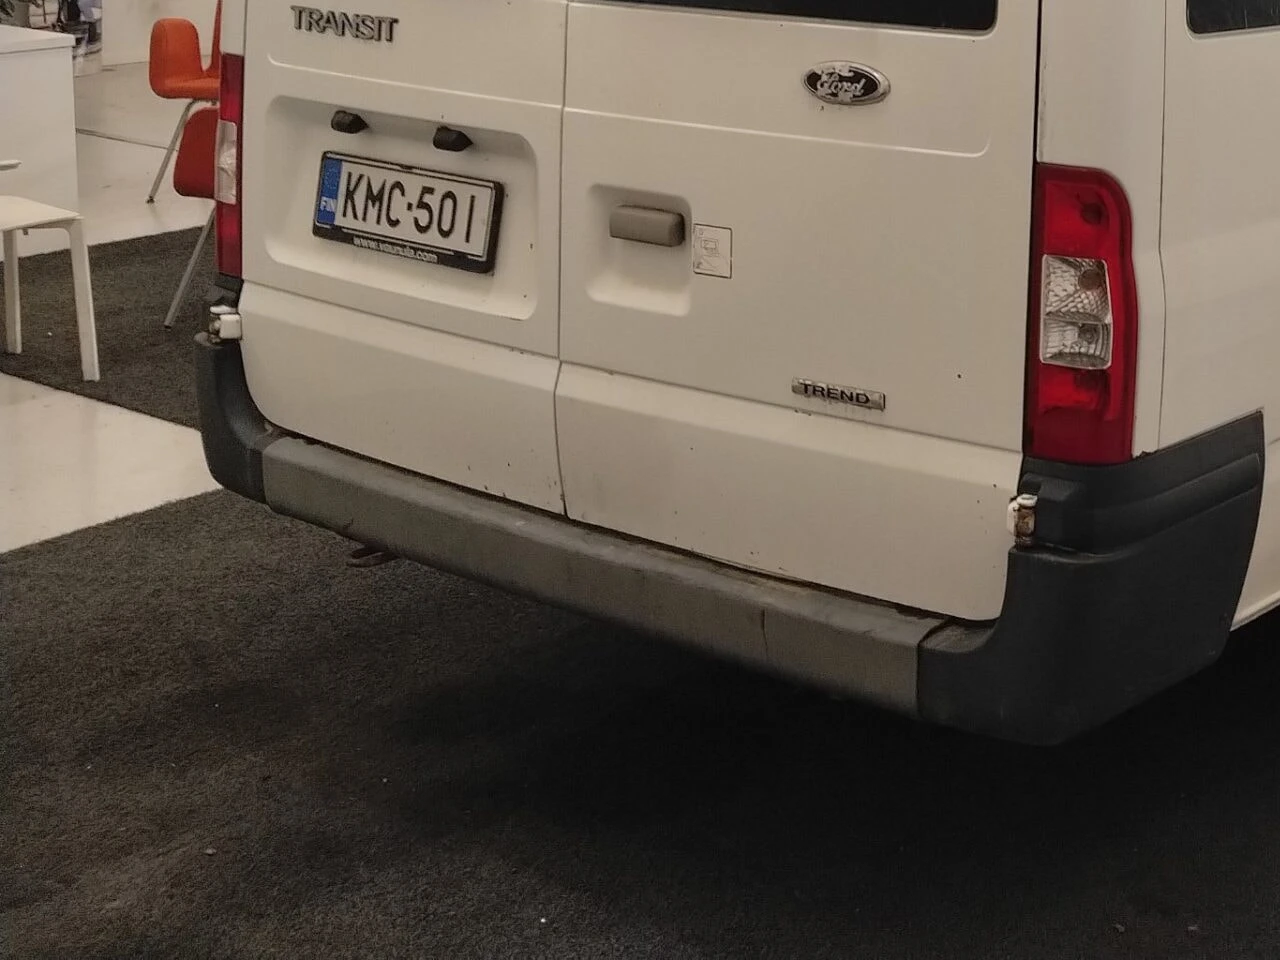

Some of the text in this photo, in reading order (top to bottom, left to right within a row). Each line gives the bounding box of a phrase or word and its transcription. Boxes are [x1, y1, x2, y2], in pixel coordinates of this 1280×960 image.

[290, 5, 399, 43] TRANSIT
[816, 71, 867, 97] Ford
[342, 171, 476, 244] KMC-501
[798, 381, 871, 405] TREND
